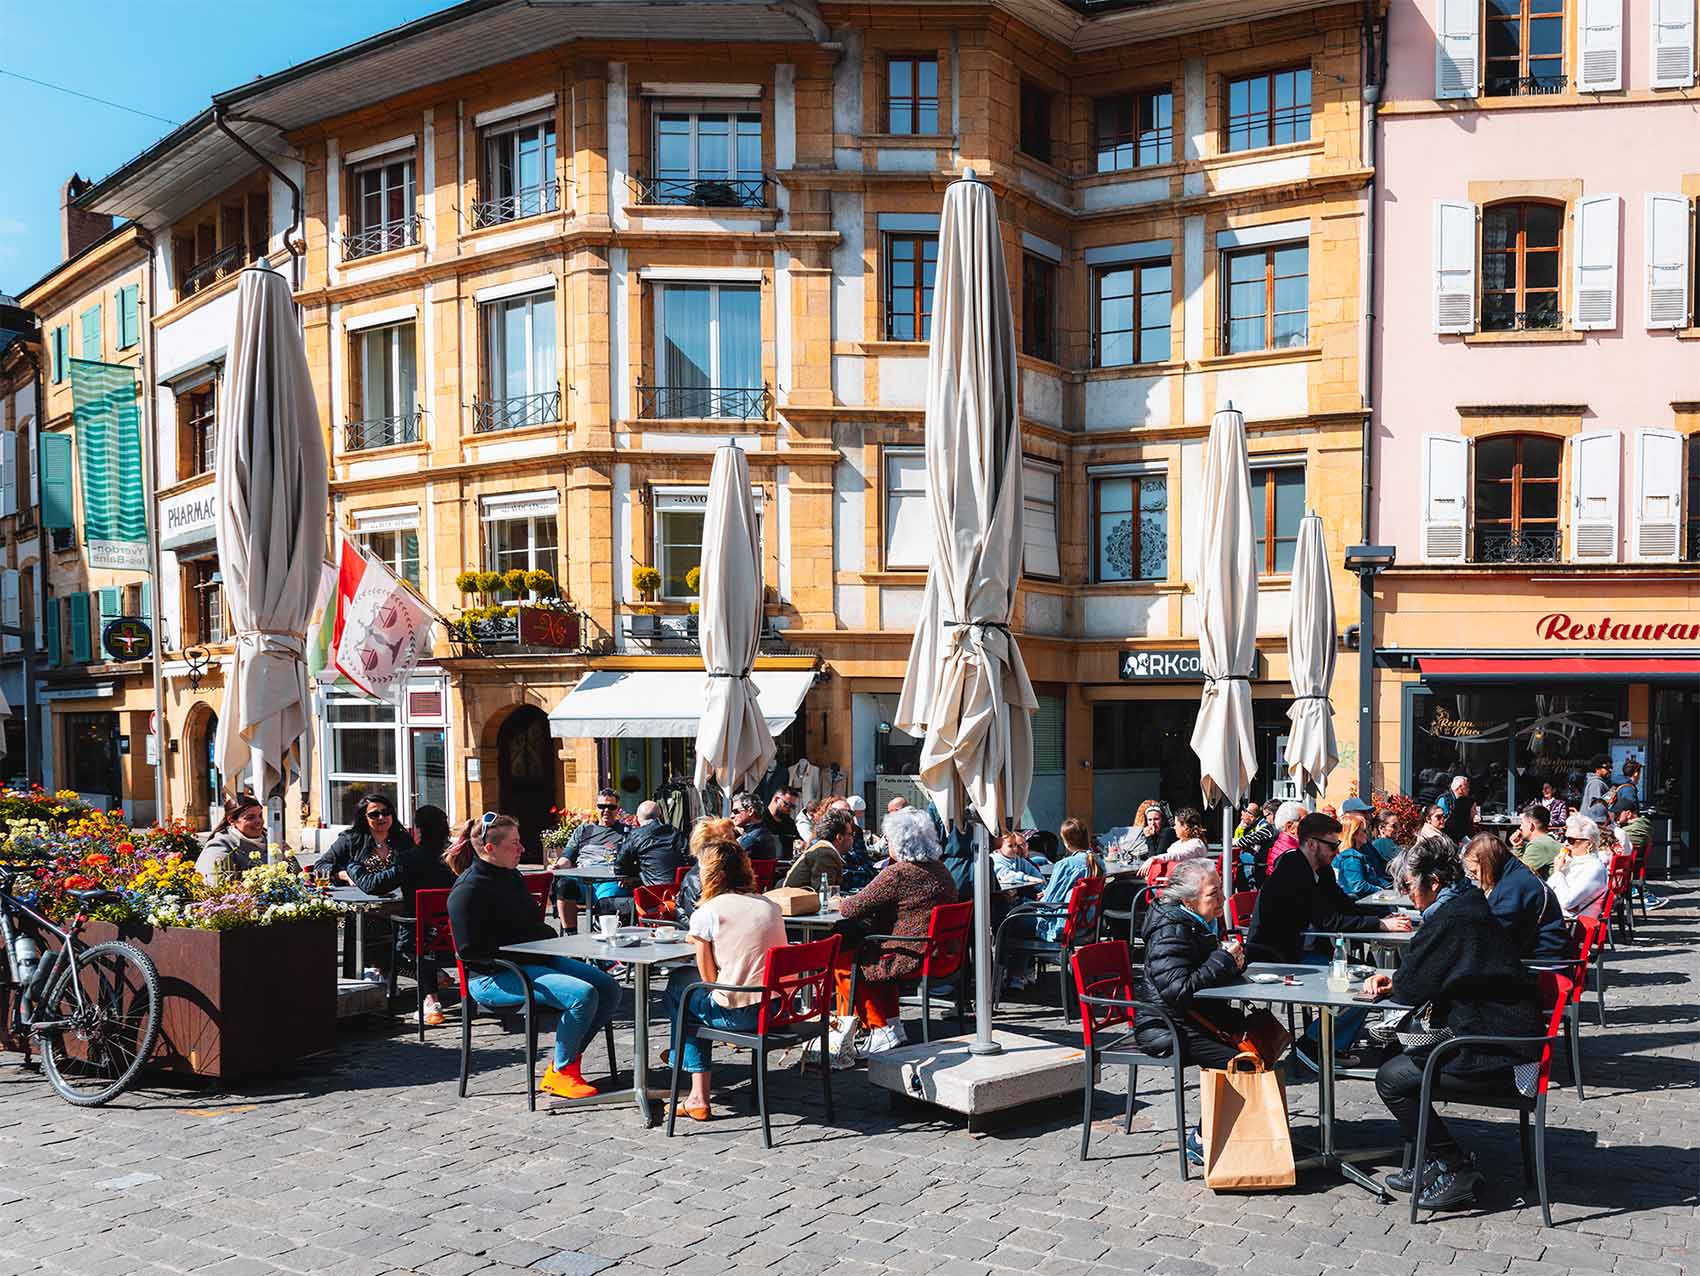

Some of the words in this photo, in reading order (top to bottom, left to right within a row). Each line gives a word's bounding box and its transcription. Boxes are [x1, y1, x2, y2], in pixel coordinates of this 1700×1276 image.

[168, 496, 215, 528] PHARMAC
[688, 495, 707, 503] AVO
[1536, 613, 1700, 640] Restauran
